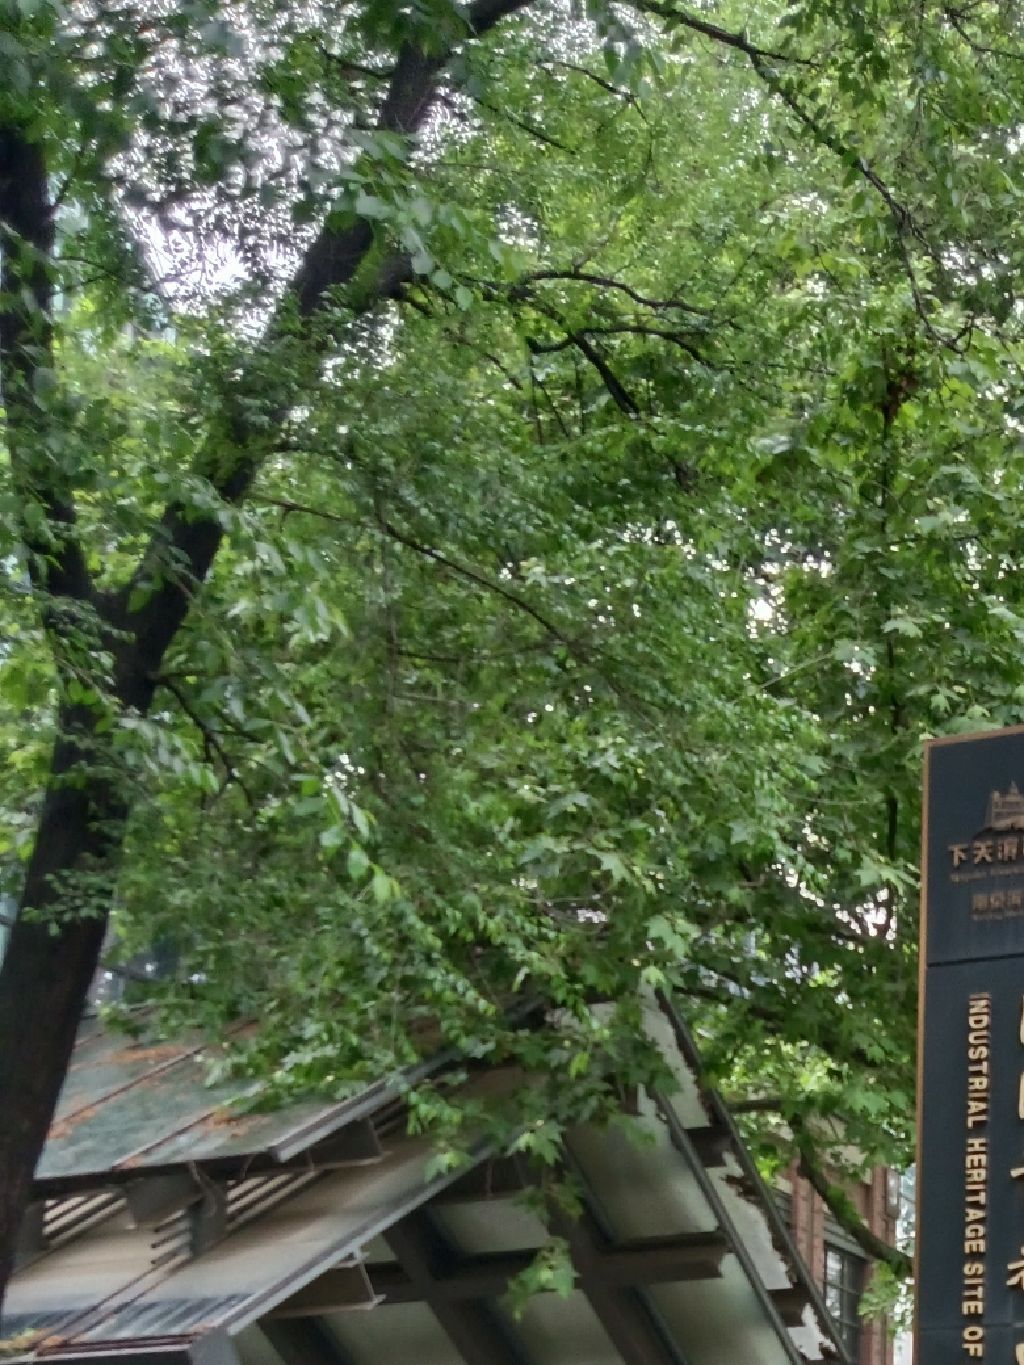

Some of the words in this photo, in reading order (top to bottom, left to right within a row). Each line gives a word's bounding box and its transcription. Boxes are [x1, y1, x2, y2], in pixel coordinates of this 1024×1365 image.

[967, 991, 991, 1129] INDUSTRIAL
[964, 1137, 988, 1254] HERITAGE
[961, 1262, 986, 1316] SITE
[961, 1325, 985, 1358] OF
